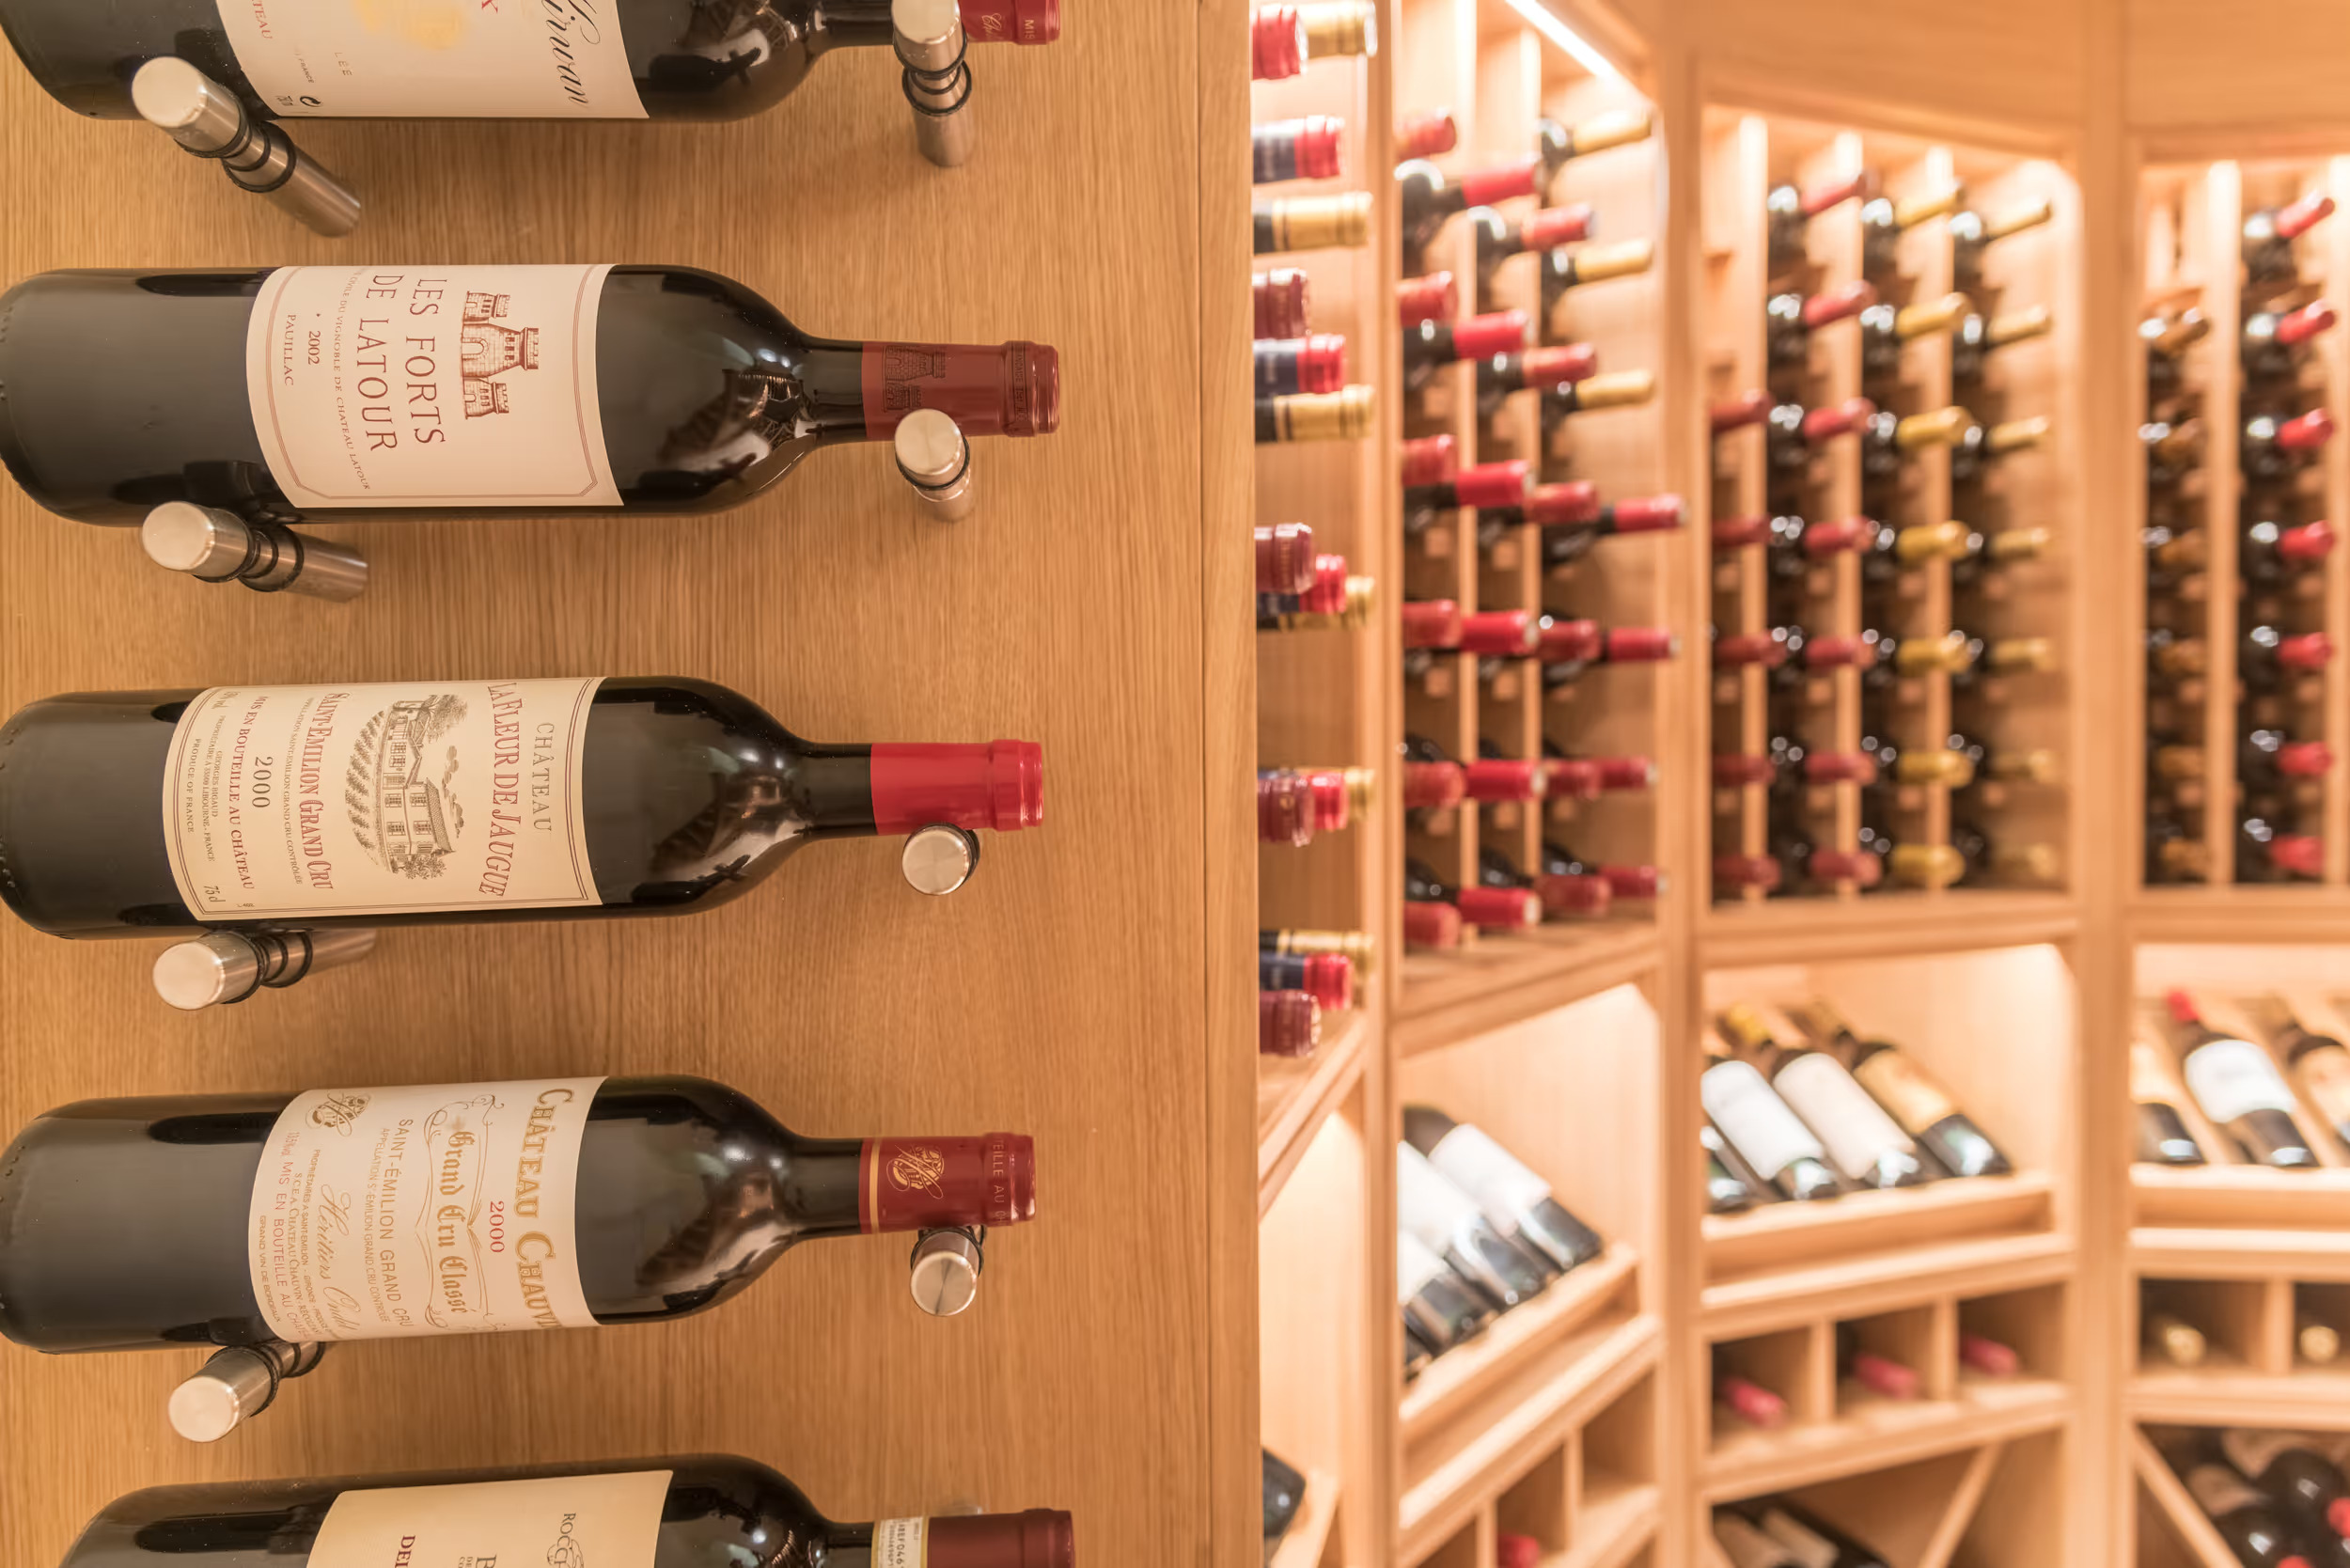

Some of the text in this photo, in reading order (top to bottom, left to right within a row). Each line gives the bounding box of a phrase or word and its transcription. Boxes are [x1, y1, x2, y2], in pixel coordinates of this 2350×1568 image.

[298, 58, 315, 84] FRANCE
[337, 300, 348, 313] DU
[366, 274, 404, 299] DE
[283, 314, 297, 386] PAUILLAC
[307, 330, 321, 366] 2002
[333, 316, 344, 372] VIGNOBLE
[405, 278, 447, 444] LES FORTS
[334, 376, 342, 392] DE
[357, 318, 398, 451] LATOUR
[336, 397, 354, 449] CHATEAU
[349, 453, 370, 490] LATOUR
[242, 712, 258, 726] EN
[185, 738, 202, 834] PRODUCE OF FRANCE
[210, 750, 224, 818] GEORGES BIGAUD
[228, 729, 252, 802] BOUTEILLE
[251, 756, 274, 808] 2000
[531, 723, 555, 832] CHÂTEAU
[201, 786, 211, 827] LIBOURNE
[283, 792, 292, 821] GRAND
[492, 773, 520, 806] DE
[228, 806, 242, 825] AU
[283, 822, 292, 839] CRU
[299, 800, 324, 857] GRAND
[204, 832, 215, 862] FRANCE
[230, 829, 255, 889] CHÂTEAU
[478, 809, 522, 897] JAUGUE
[203, 886, 221, 895] 75
[306, 860, 334, 889] CRU
[278, 1161, 294, 1185] MIS
[368, 1128, 391, 1181] APPELLATION
[513, 1088, 575, 1219] CHÂTEAU
[274, 1193, 288, 1210] EN
[993, 1184, 1006, 1203] AU
[317, 1184, 352, 1280] Héritiers
[379, 1119, 415, 1326] SAINT-ÉMILION GRAND CRU
[436, 1131, 478, 1313] Grand Cru Classé
[490, 1200, 506, 1253] 2000
[258, 1215, 281, 1323] GRAND VIN DE BORDEAUX
[272, 1218, 288, 1287] BOUTEILLE
[364, 1233, 375, 1265] GRAND
[289, 1259, 304, 1300] CHAUVIN
[303, 1275, 317, 1303] GIRONDE
[366, 1267, 377, 1285] CRU
[279, 1293, 294, 1308] AU
